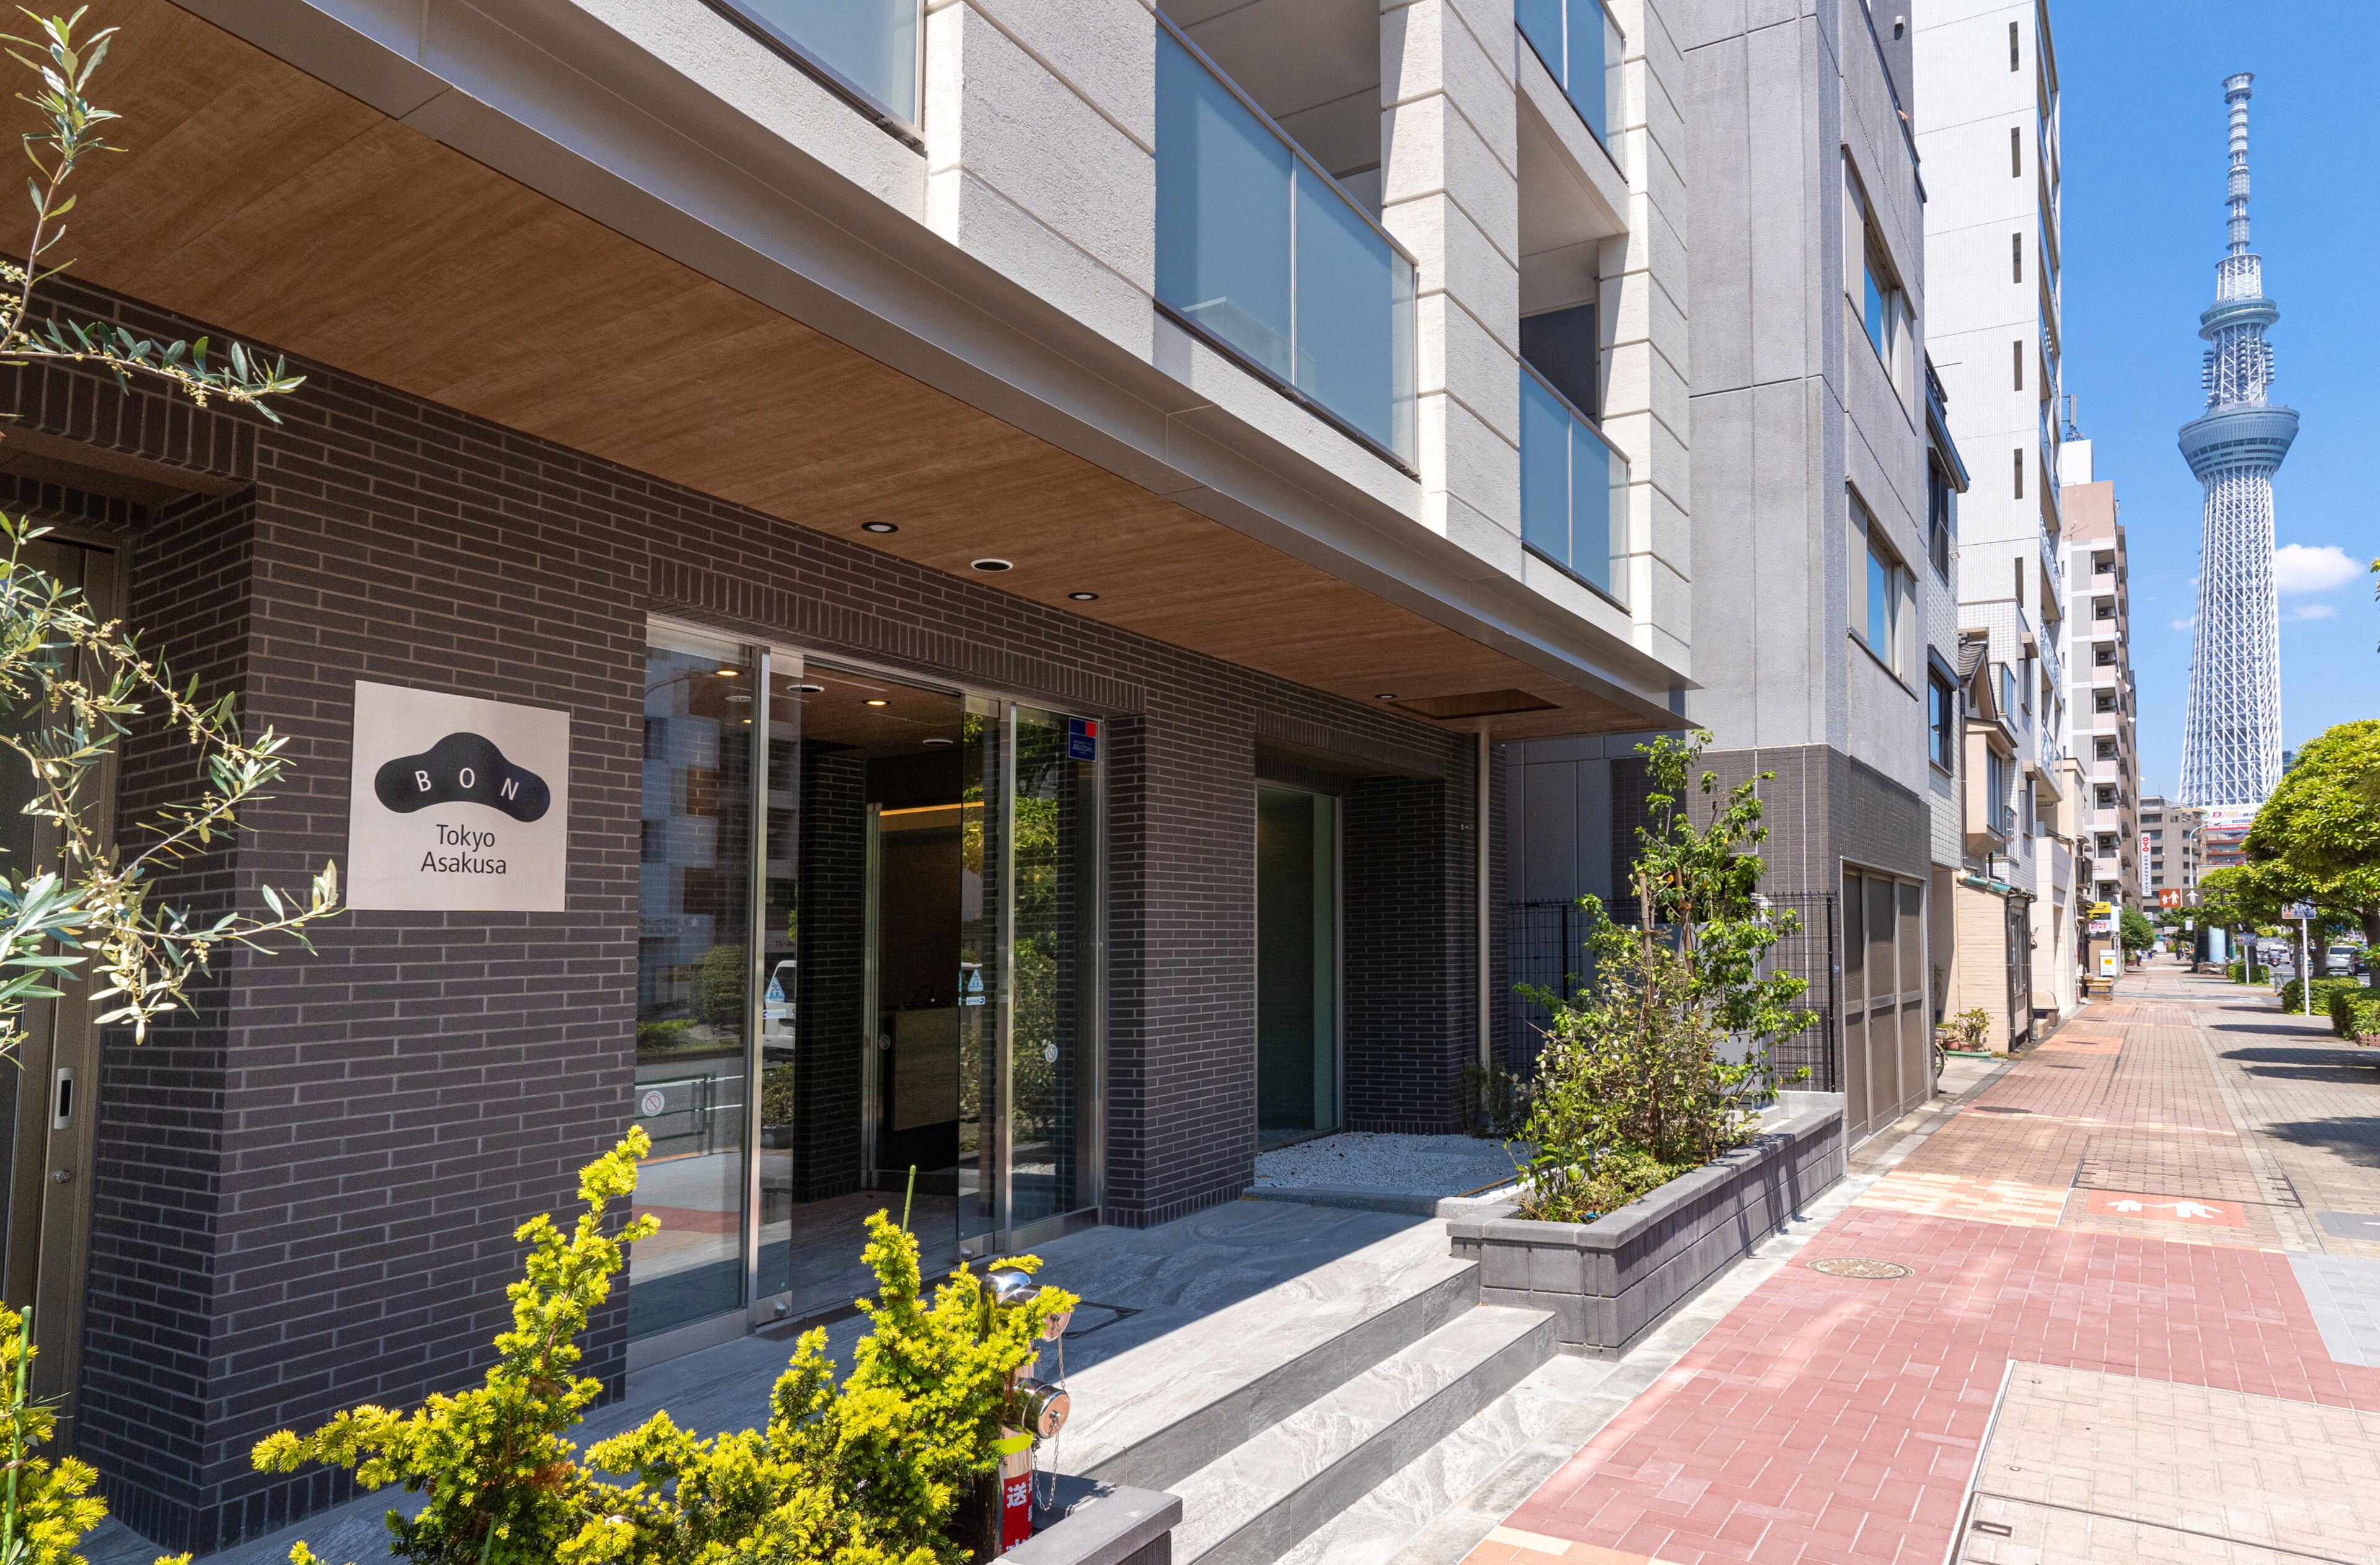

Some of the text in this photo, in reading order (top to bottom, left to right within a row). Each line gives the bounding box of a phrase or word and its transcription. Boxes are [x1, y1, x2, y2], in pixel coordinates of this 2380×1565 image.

[415, 768, 519, 801] BON
[436, 824, 495, 852] Tokyo
[420, 851, 506, 875] Asakusa
